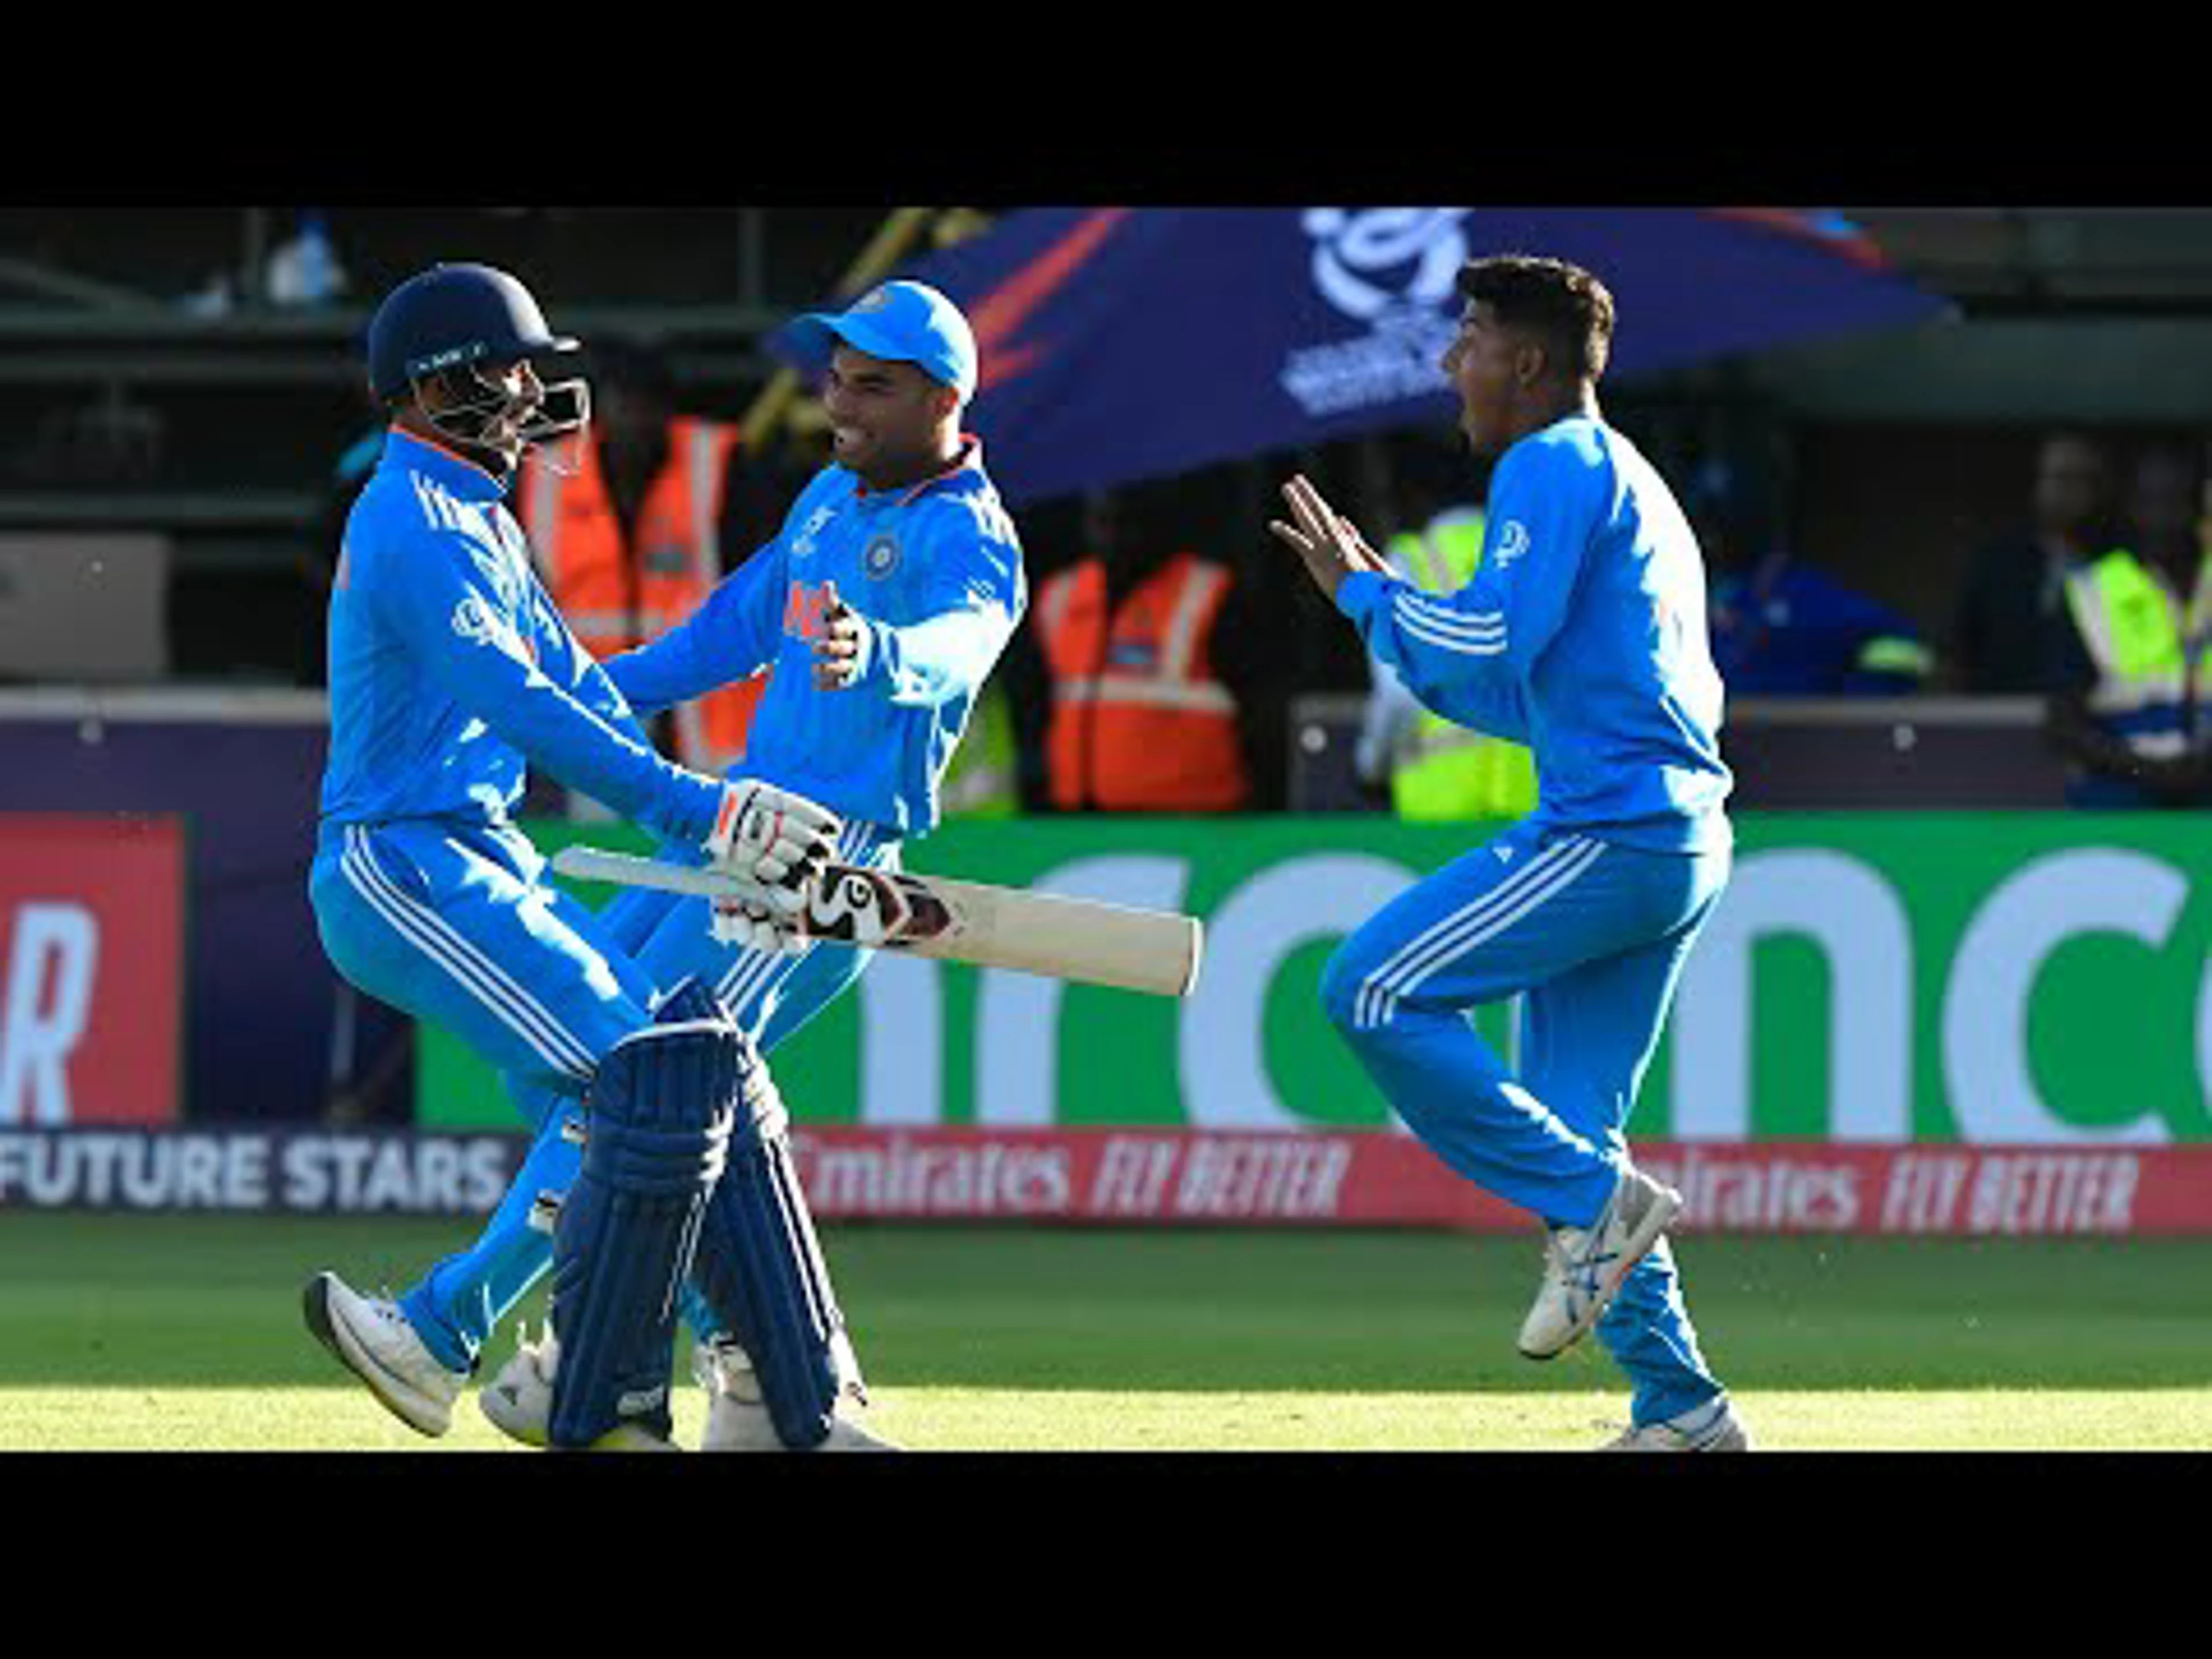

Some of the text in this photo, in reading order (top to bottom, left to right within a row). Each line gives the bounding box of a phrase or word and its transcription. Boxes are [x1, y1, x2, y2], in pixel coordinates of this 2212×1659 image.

[0, 1135, 507, 1208] FUTURE STARS
[1090, 1137, 1178, 1214] FLY
[1178, 1139, 1351, 1215] BETTER
[1967, 1154, 2139, 1234] BETTER
